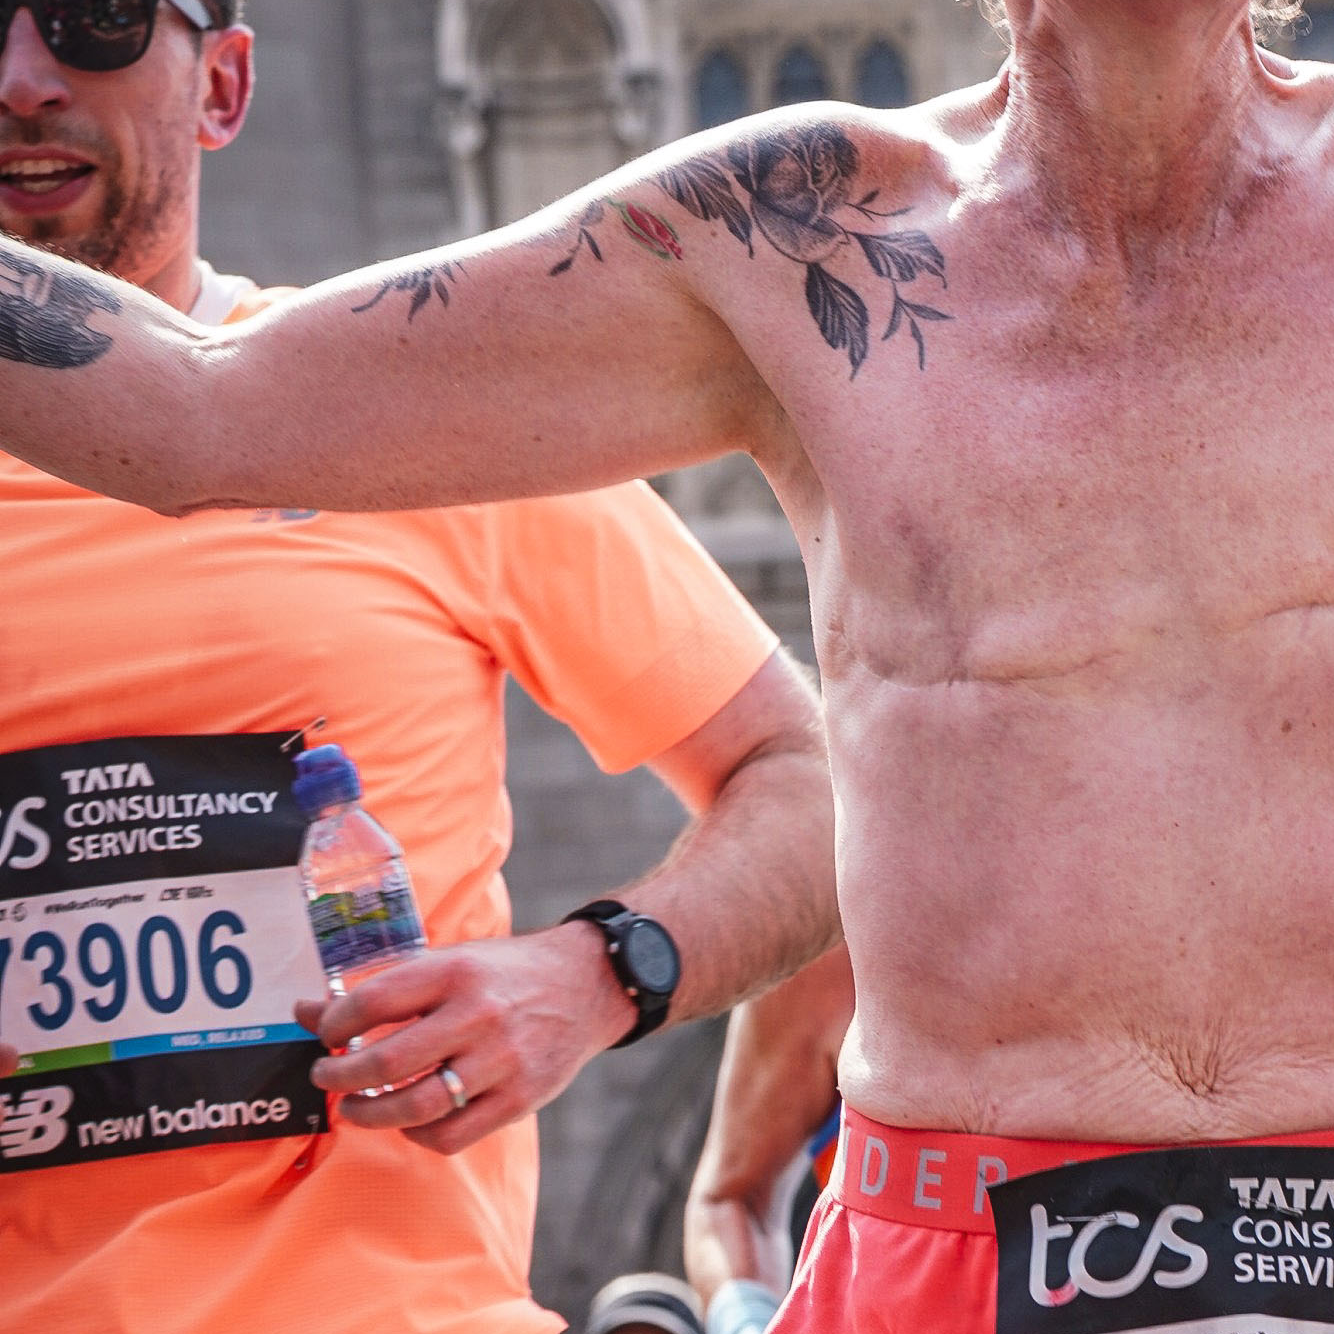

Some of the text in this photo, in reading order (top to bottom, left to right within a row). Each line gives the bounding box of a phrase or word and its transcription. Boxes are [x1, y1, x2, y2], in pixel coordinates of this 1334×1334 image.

[61, 762, 155, 795] TATA
[64, 791, 279, 828] CONSULTANCY
[66, 824, 203, 863] SERVICES
[78, 1097, 291, 1147] new balance
